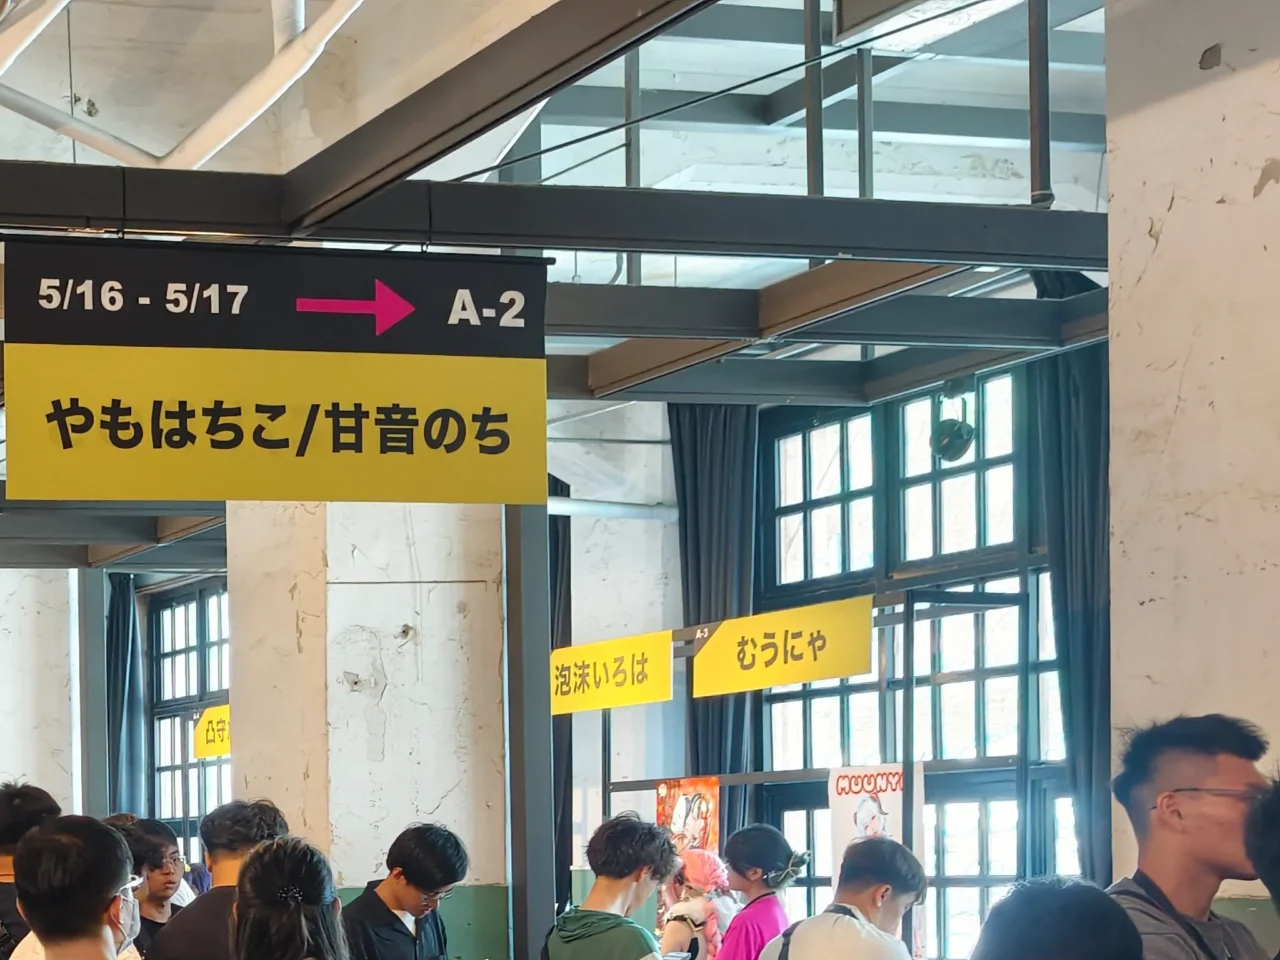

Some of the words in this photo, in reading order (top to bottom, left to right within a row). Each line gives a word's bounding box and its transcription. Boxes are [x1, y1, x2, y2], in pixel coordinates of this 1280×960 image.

[38, 278, 124, 312] 5/16
[138, 296, 151, 305] -
[165, 282, 249, 315] 5/17
[447, 288, 526, 328] A-2
[45, 397, 511, 458] やもはちこ/甘音のち
[736, 629, 827, 671] むうにゃ
[554, 652, 648, 697] 泡沫いろは
[206, 718, 230, 744] 凸守
